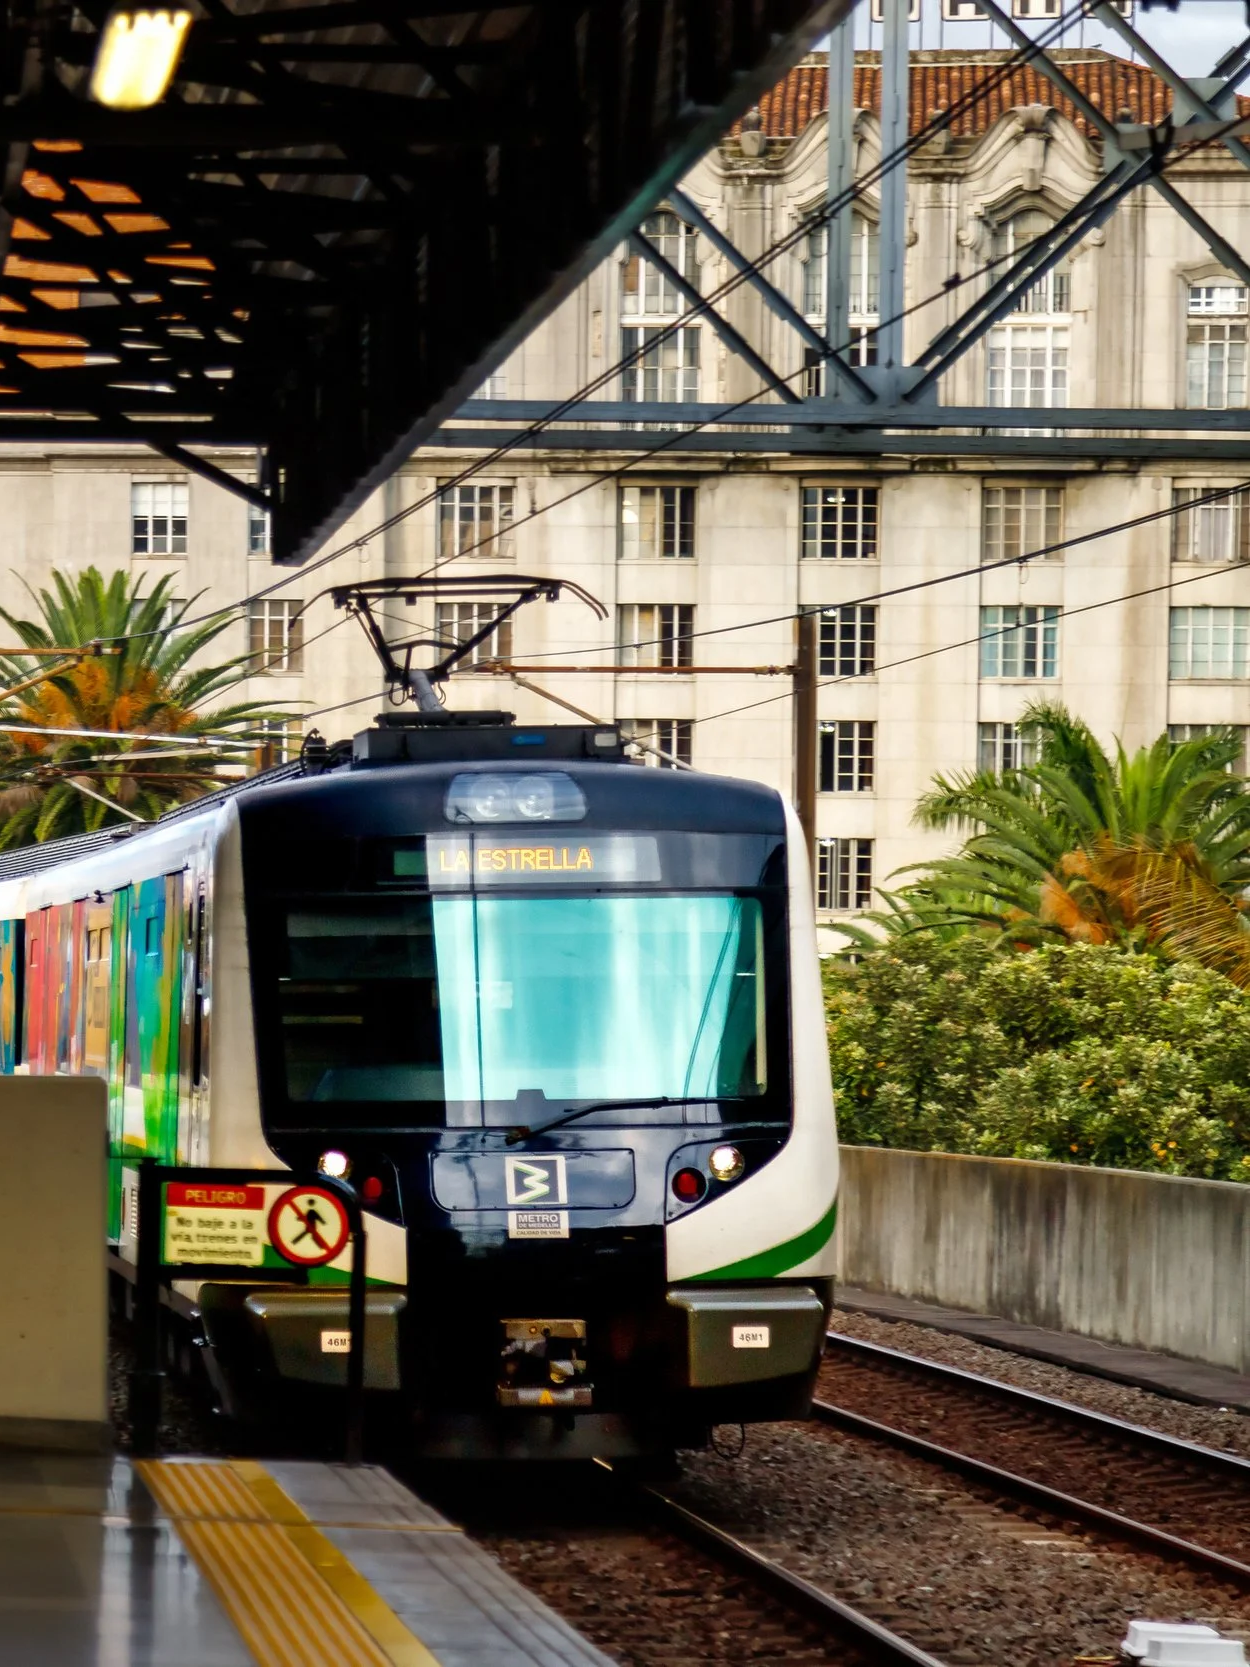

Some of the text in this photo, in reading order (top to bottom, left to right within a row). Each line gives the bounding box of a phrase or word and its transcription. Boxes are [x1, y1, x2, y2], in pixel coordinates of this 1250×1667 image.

[440, 848, 592, 872] LA ESTRELLA
[185, 1190, 246, 1204] PELIGRO
[177, 1217, 192, 1228] No
[230, 1221, 237, 1229] a
[242, 1219, 254, 1230] la
[518, 1214, 558, 1223] METRO
[739, 1333, 763, 1342] 46M1
